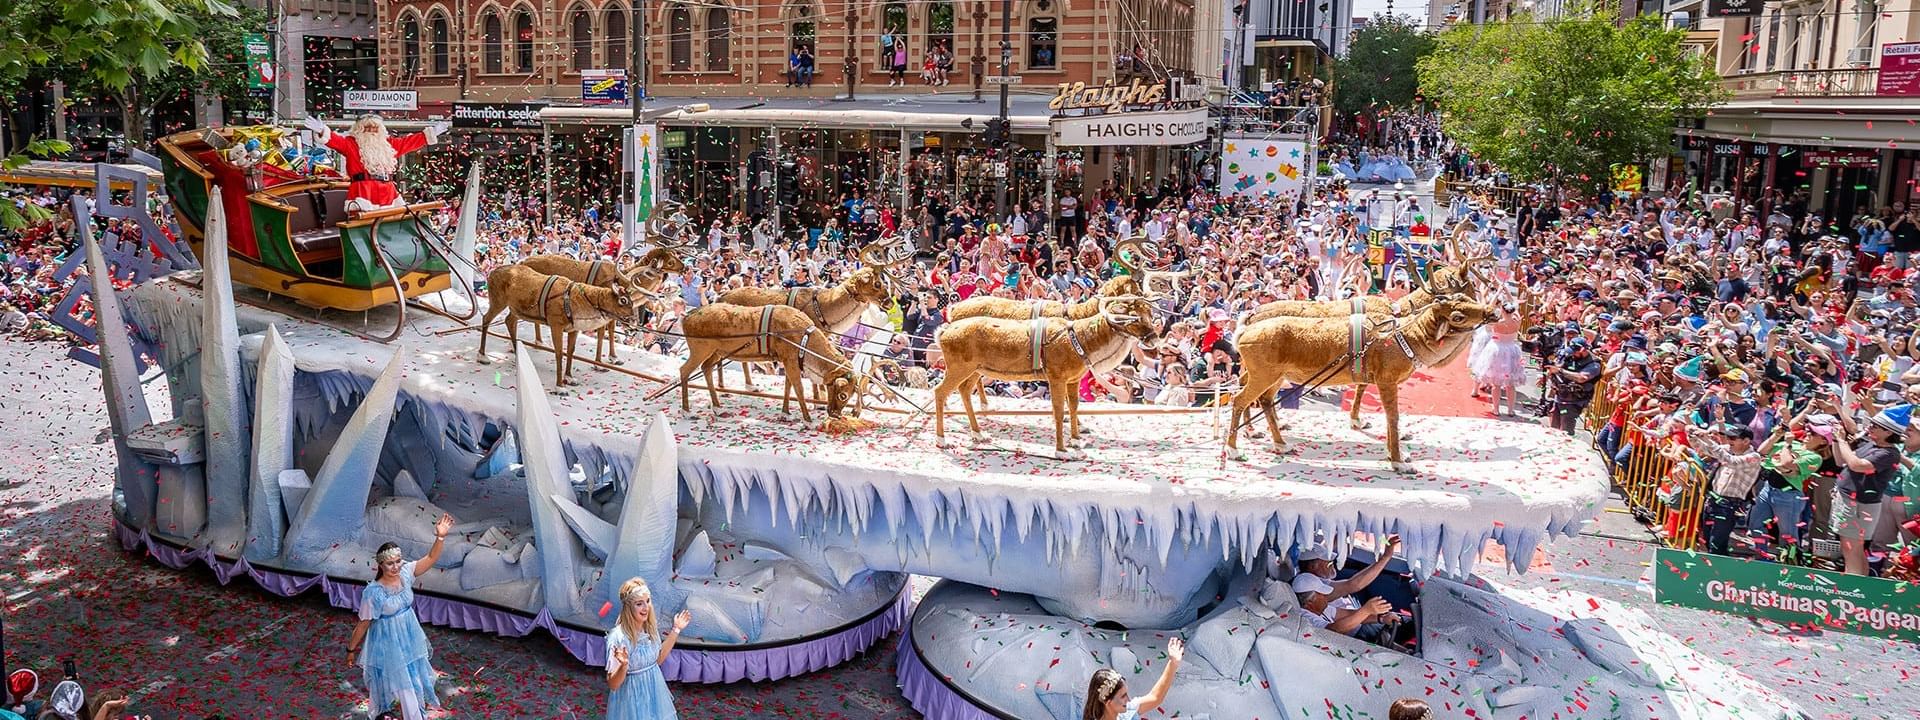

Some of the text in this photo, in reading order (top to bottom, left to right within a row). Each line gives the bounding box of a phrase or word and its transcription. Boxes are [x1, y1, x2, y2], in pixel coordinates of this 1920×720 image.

[1885, 46, 1910, 54] Retail
[349, 92, 412, 101] OPAL DIAMOND
[455, 105, 541, 119] attention seeke
[1087, 123, 1164, 137] HAIGH'S
[1714, 144, 1769, 154] SUSH HU
[1777, 579, 1866, 599] National Pharmacies
[1706, 579, 1829, 617] Christmas
